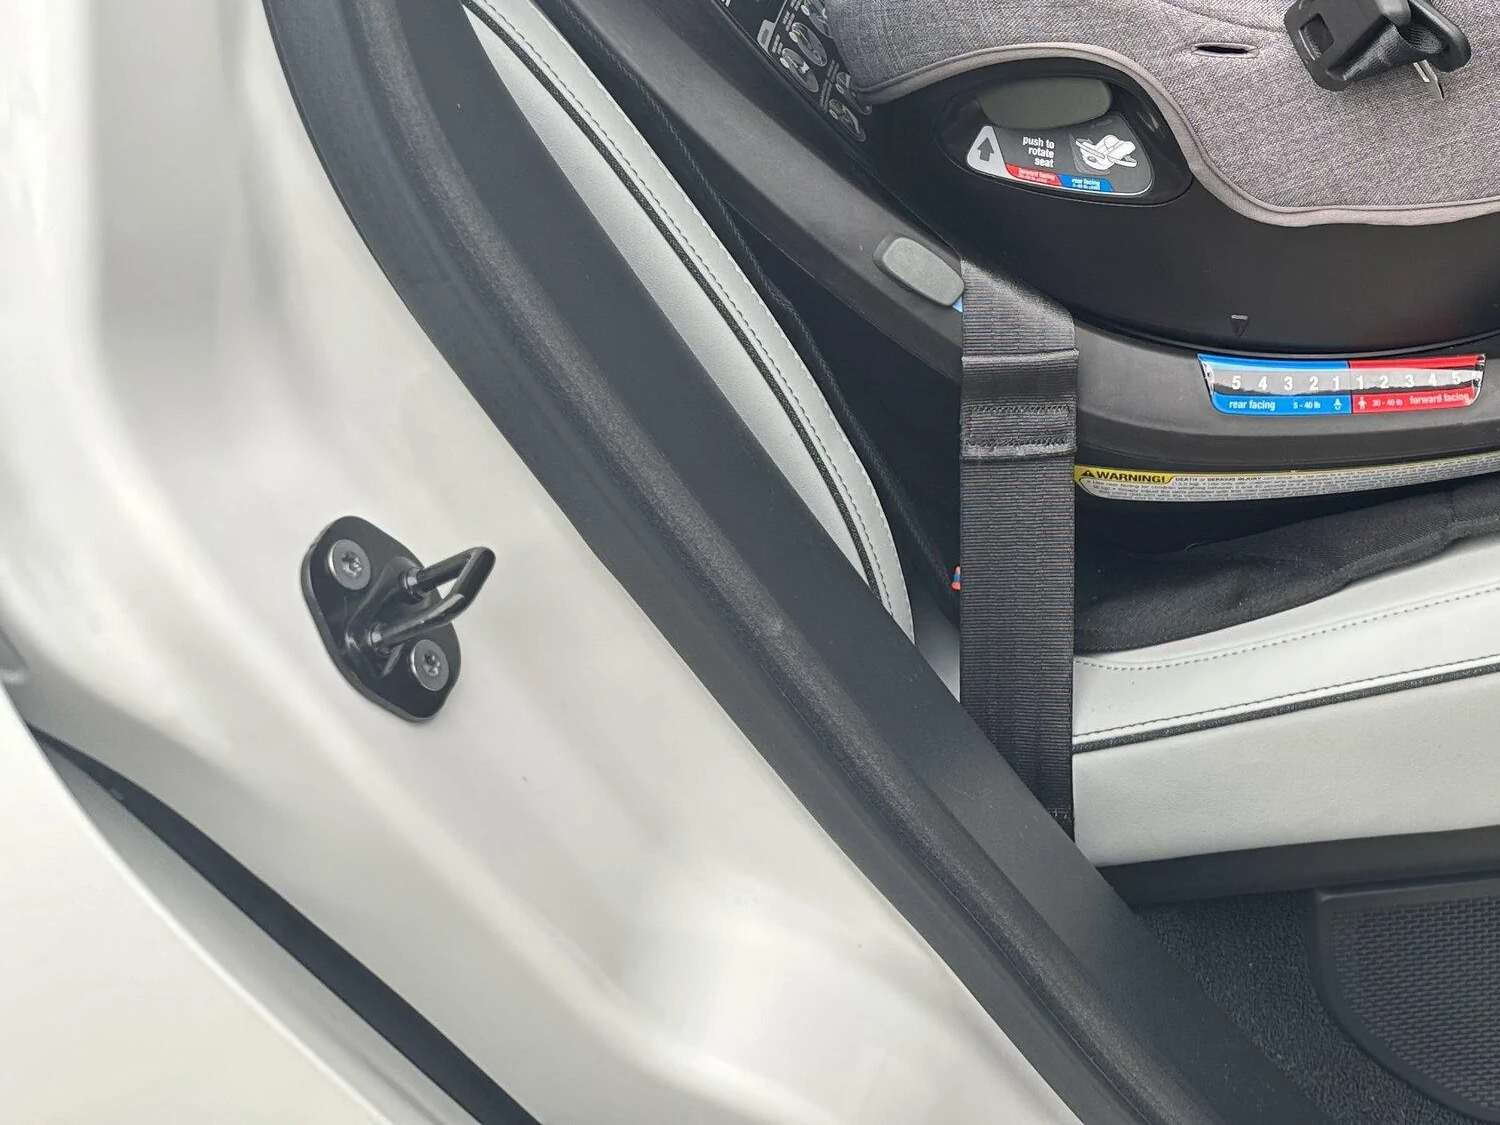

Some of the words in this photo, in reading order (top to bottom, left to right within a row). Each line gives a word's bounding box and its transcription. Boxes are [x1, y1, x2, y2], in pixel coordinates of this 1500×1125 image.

[1023, 136, 1044, 148] push
[1046, 139, 1055, 149] to
[1028, 146, 1055, 159] rotate
[1034, 157, 1055, 168] seat
[1231, 375, 1241, 390] 5
[1258, 376, 1267, 391] 4
[1284, 376, 1293, 391] 3
[1309, 376, 1319, 391] 2
[1333, 376, 1340, 390] 1
[1356, 375, 1364, 389] 1
[1380, 375, 1389, 388] 2
[1405, 375, 1415, 388] 3
[1428, 372, 1437, 386] 4
[1451, 371, 1461, 384] 5
[1409, 394, 1442, 405] forward
[1444, 391, 1470, 402] facing
[1229, 400, 1246, 409] rear
[1249, 400, 1276, 411] facing
[1304, 401, 1313, 409] 40
[1313, 401, 1321, 409] lb
[1096, 470, 1166, 483] WARNING!
